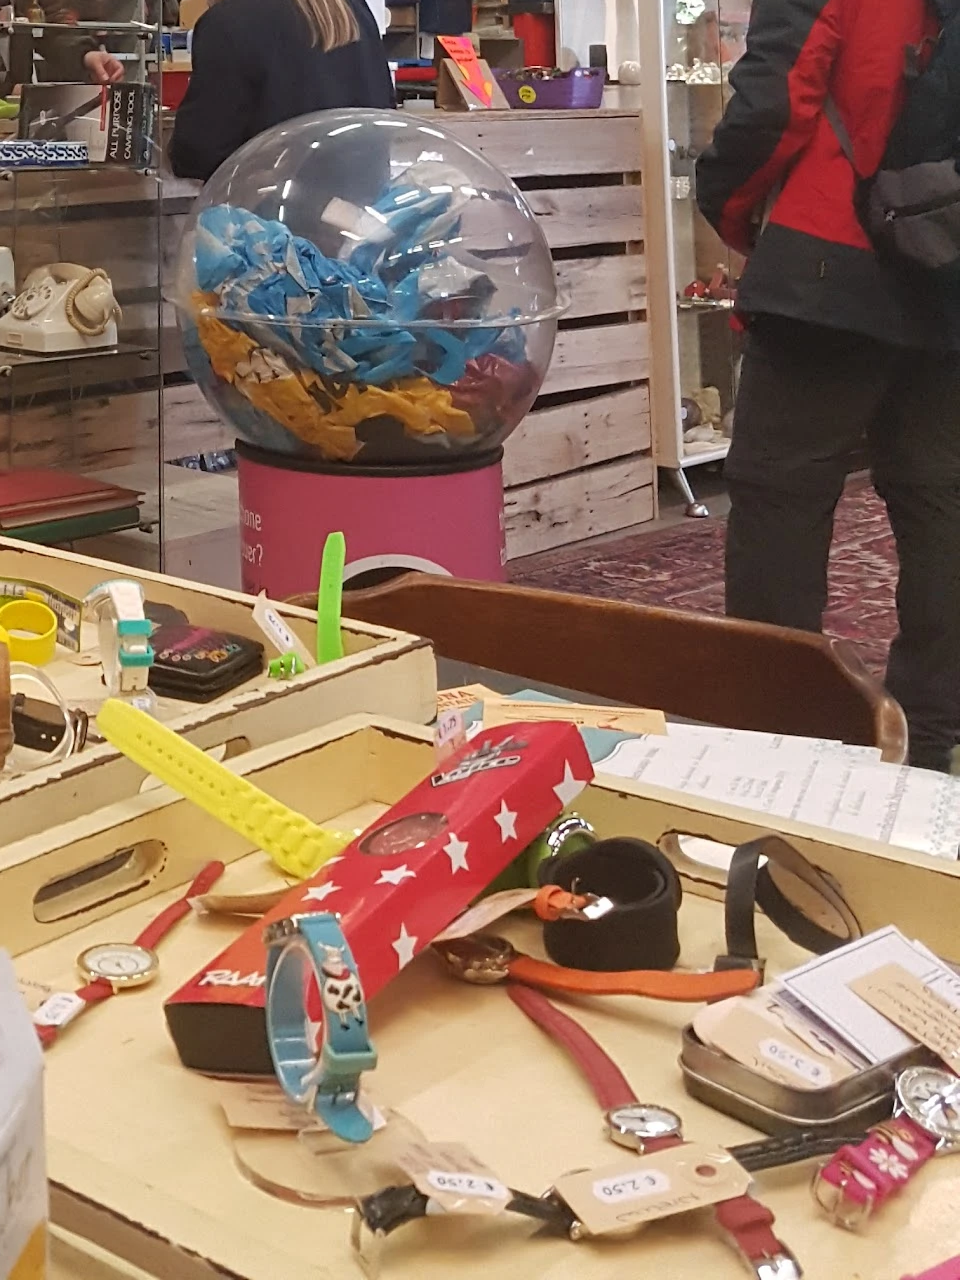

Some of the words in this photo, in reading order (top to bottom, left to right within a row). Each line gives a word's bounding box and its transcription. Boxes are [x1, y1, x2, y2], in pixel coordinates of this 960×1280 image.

[127, 90, 135, 114] TOOL
[111, 90, 122, 138] PURPOSE
[109, 141, 118, 159] ALL
[198, 970, 266, 986] RAA
[602, 1179, 640, 1196] 2.50
